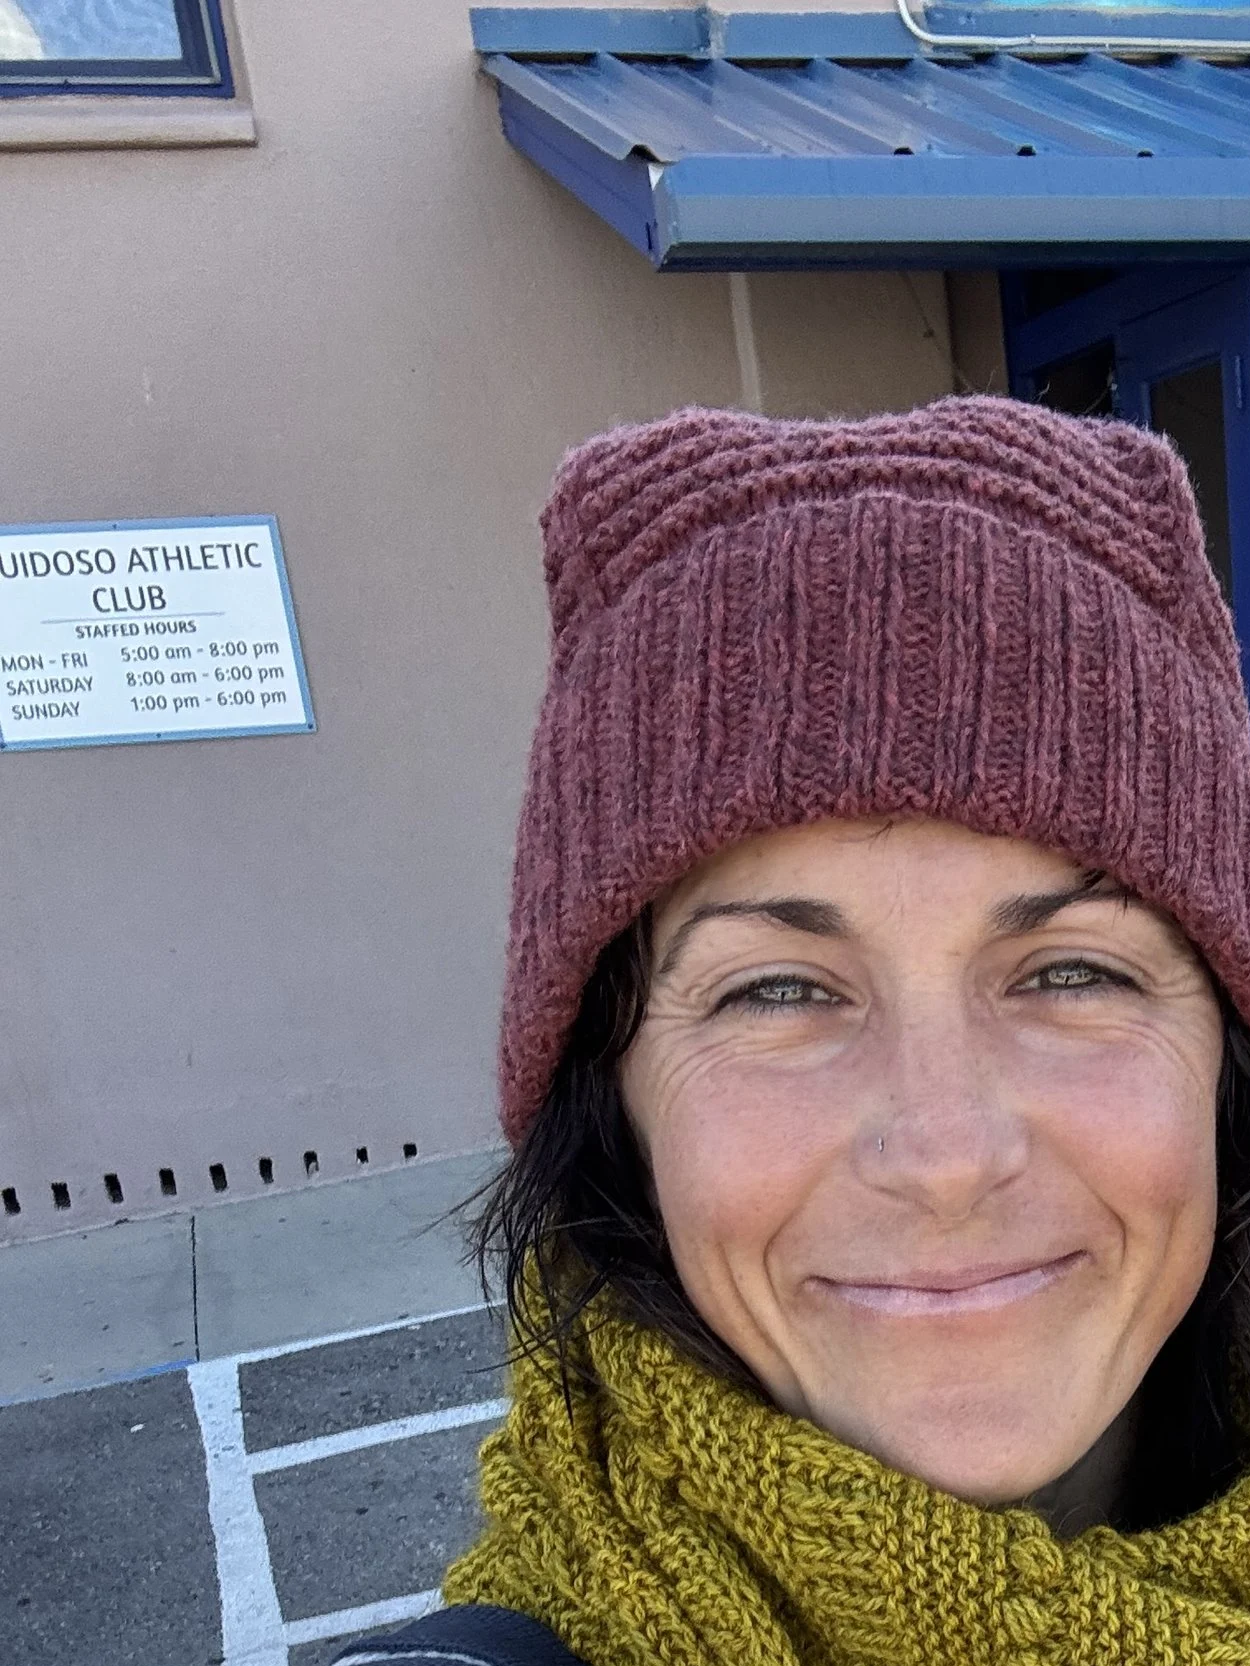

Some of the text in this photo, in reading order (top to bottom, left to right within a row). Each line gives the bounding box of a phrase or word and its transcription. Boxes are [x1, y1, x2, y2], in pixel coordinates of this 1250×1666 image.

[127, 542, 263, 574] ATHLETIC
[92, 584, 167, 613] CLUB
[75, 619, 197, 640] STAFFED HOURS
[0, 653, 45, 673] MON
[61, 651, 89, 669] FRI
[120, 644, 160, 663] 5:00
[165, 646, 192, 661] am
[208, 640, 248, 658] 8:00
[252, 641, 280, 660] pm
[6, 675, 94, 697] SATURDAY
[125, 669, 165, 688] 8:00
[170, 670, 197, 685] am
[214, 665, 253, 682] 6:00
[258, 666, 285, 684] pm
[11, 700, 81, 721] SUNDAY
[130, 694, 168, 712] 1:00
[173, 694, 200, 713] pm
[216, 689, 255, 707] 6:00
[260, 690, 287, 709] pm
